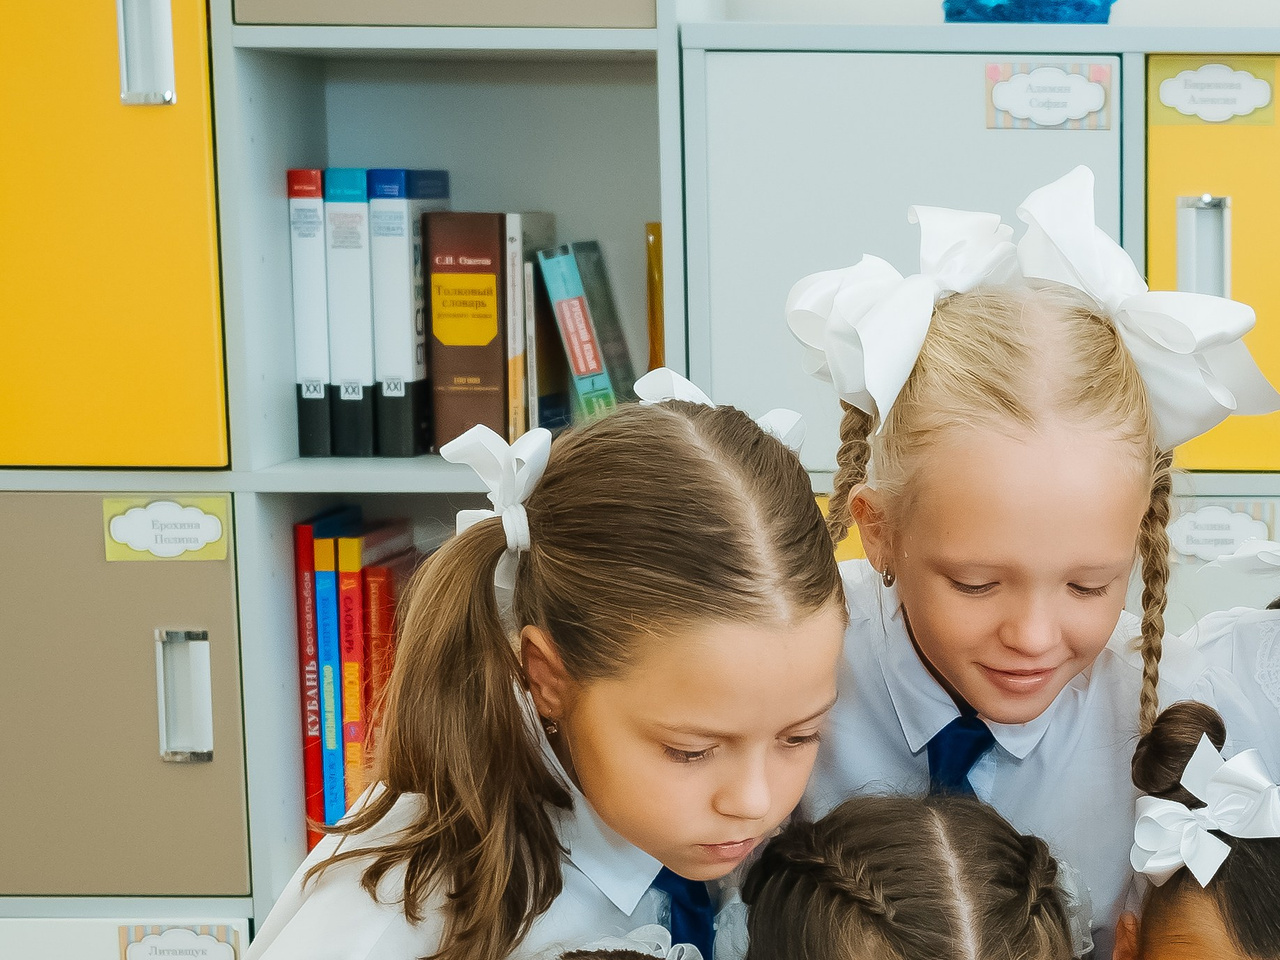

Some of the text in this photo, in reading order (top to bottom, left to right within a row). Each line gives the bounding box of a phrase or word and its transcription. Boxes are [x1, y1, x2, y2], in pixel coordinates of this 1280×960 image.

[1029, 98, 1068, 110] София
[435, 285, 494, 296] Толковый
[442, 300, 487, 310] словарь
[152, 520, 200, 531] Ерохина
[154, 534, 199, 544] Полина
[305, 661, 320, 737] КУБАНЬ
